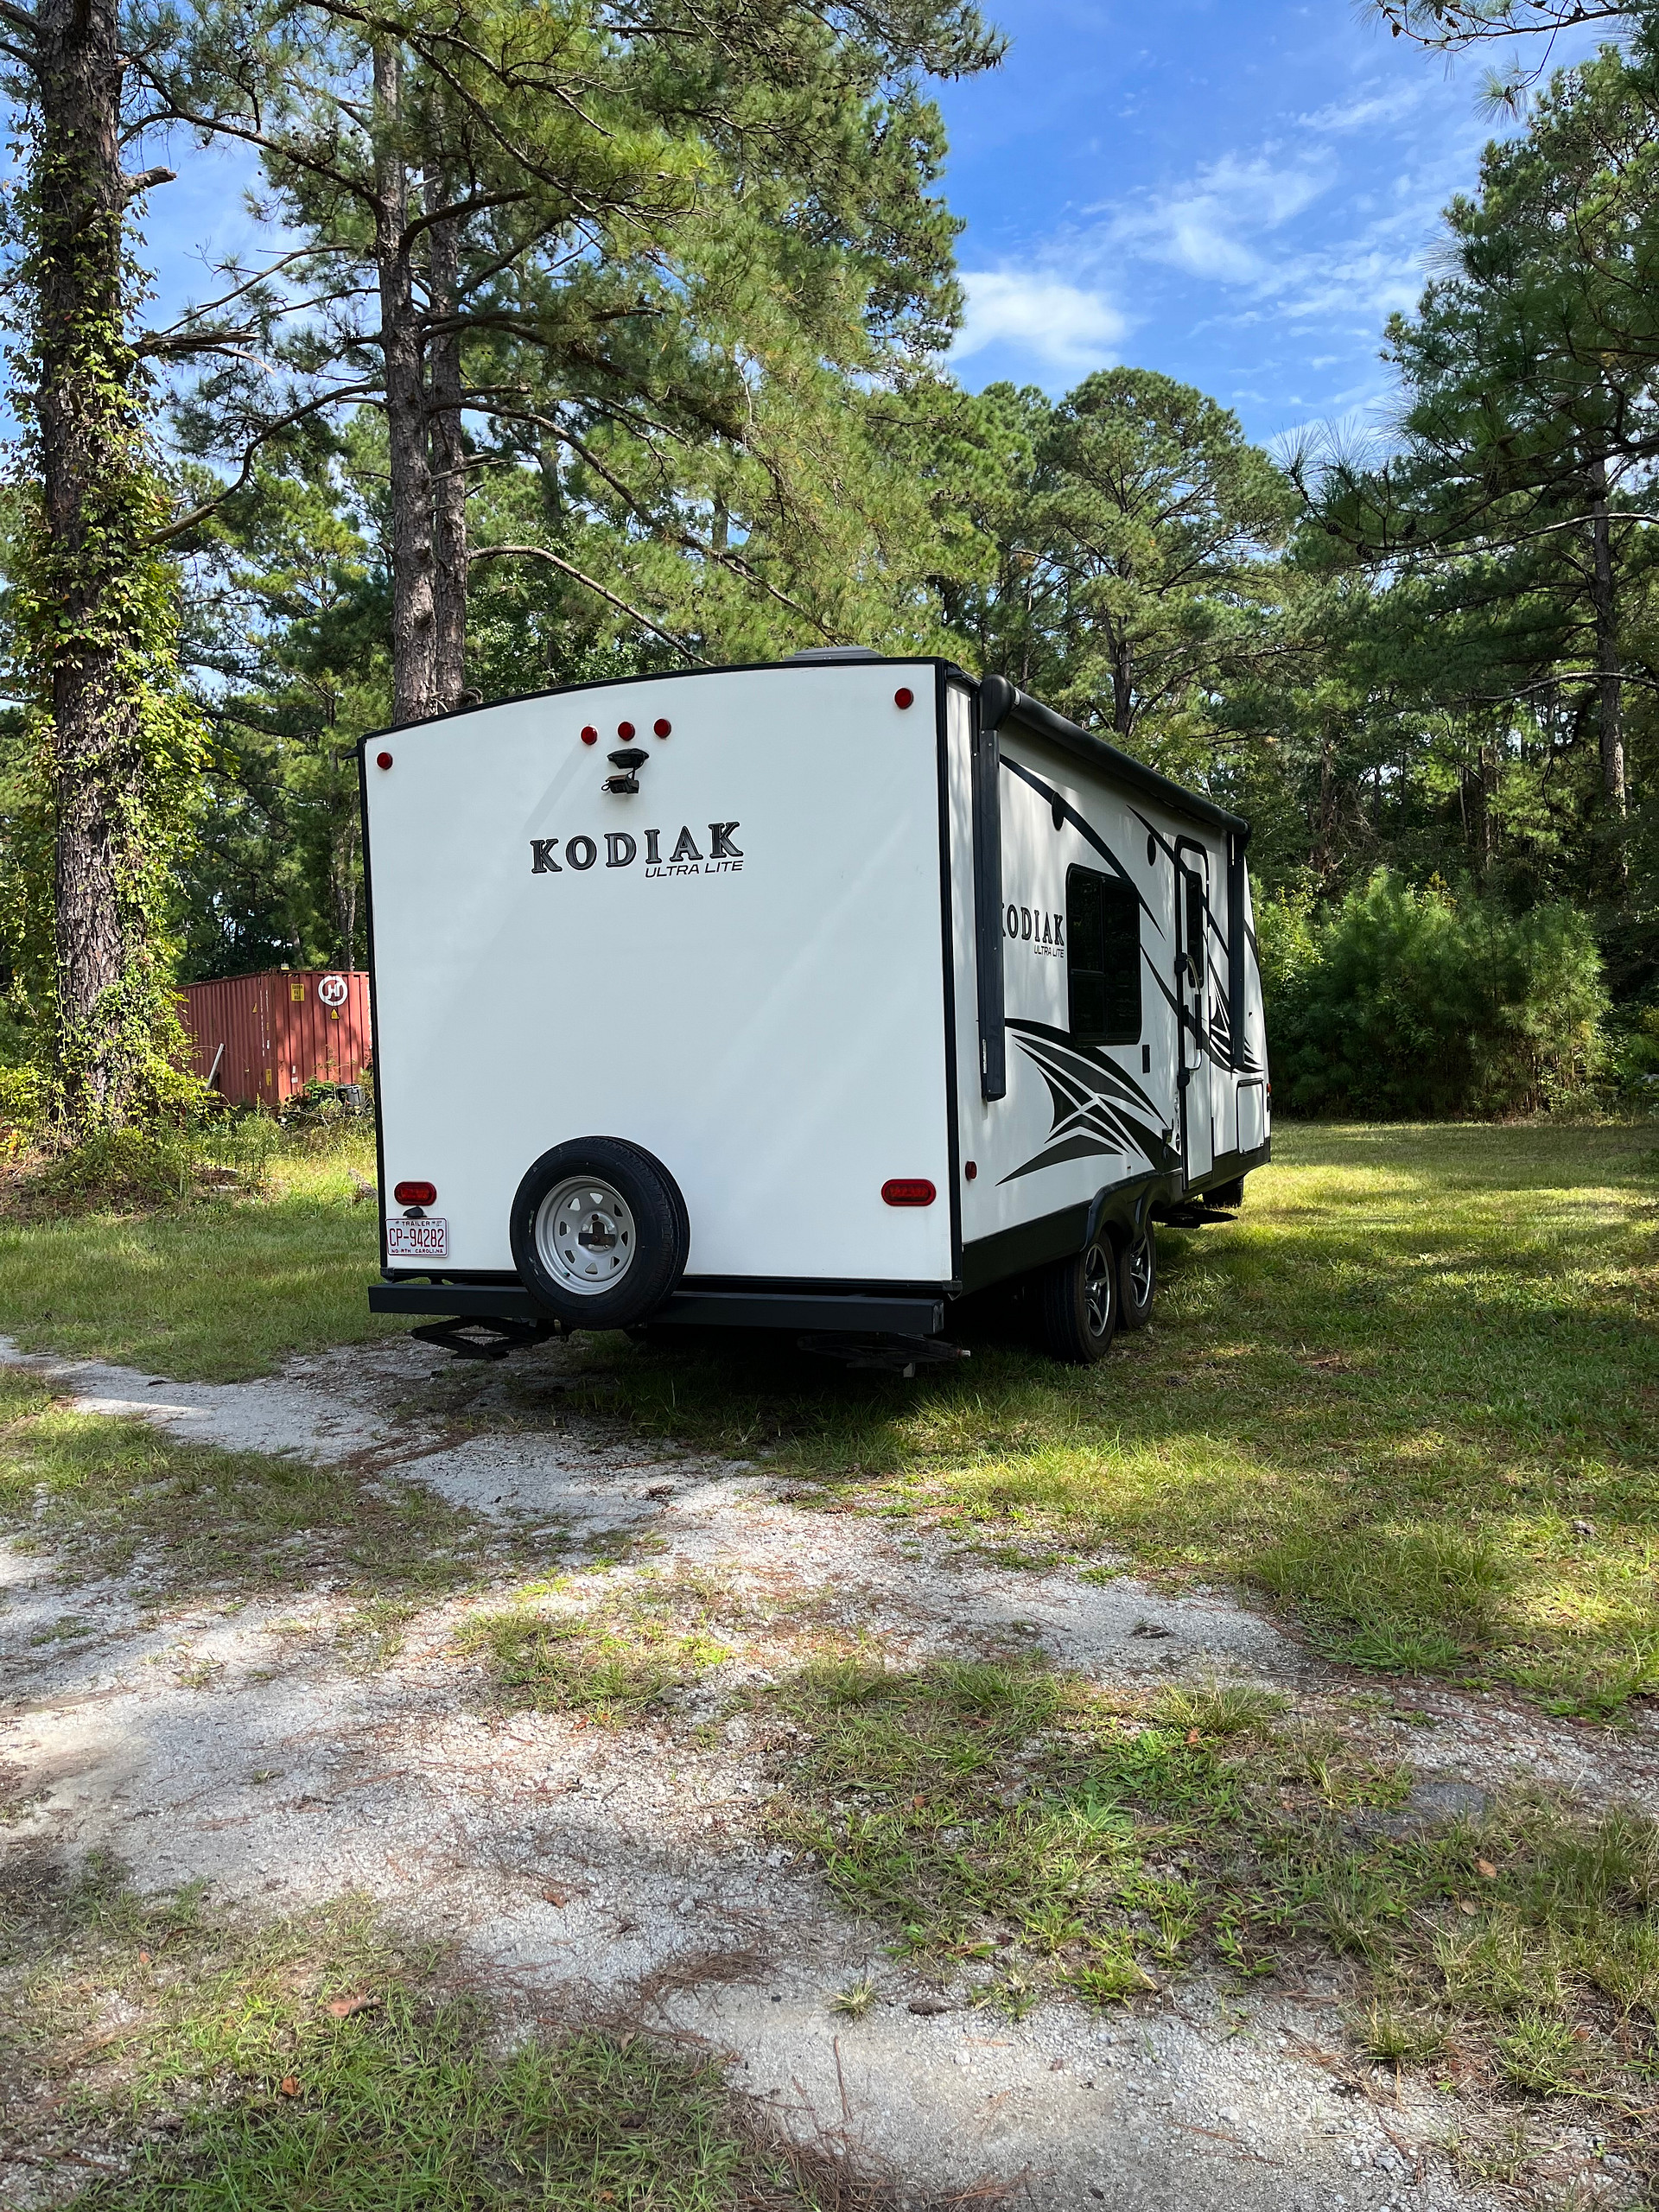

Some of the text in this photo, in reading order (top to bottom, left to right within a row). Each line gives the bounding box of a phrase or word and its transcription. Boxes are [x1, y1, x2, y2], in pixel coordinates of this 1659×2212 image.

[530, 822, 744, 874] KODIAK
[645, 860, 744, 878] ULTRA LITE
[1001, 903, 1065, 946] ODIAK
[1033, 944, 1065, 958] ULTRA LITE
[389, 1228, 445, 1248] CP-94282
